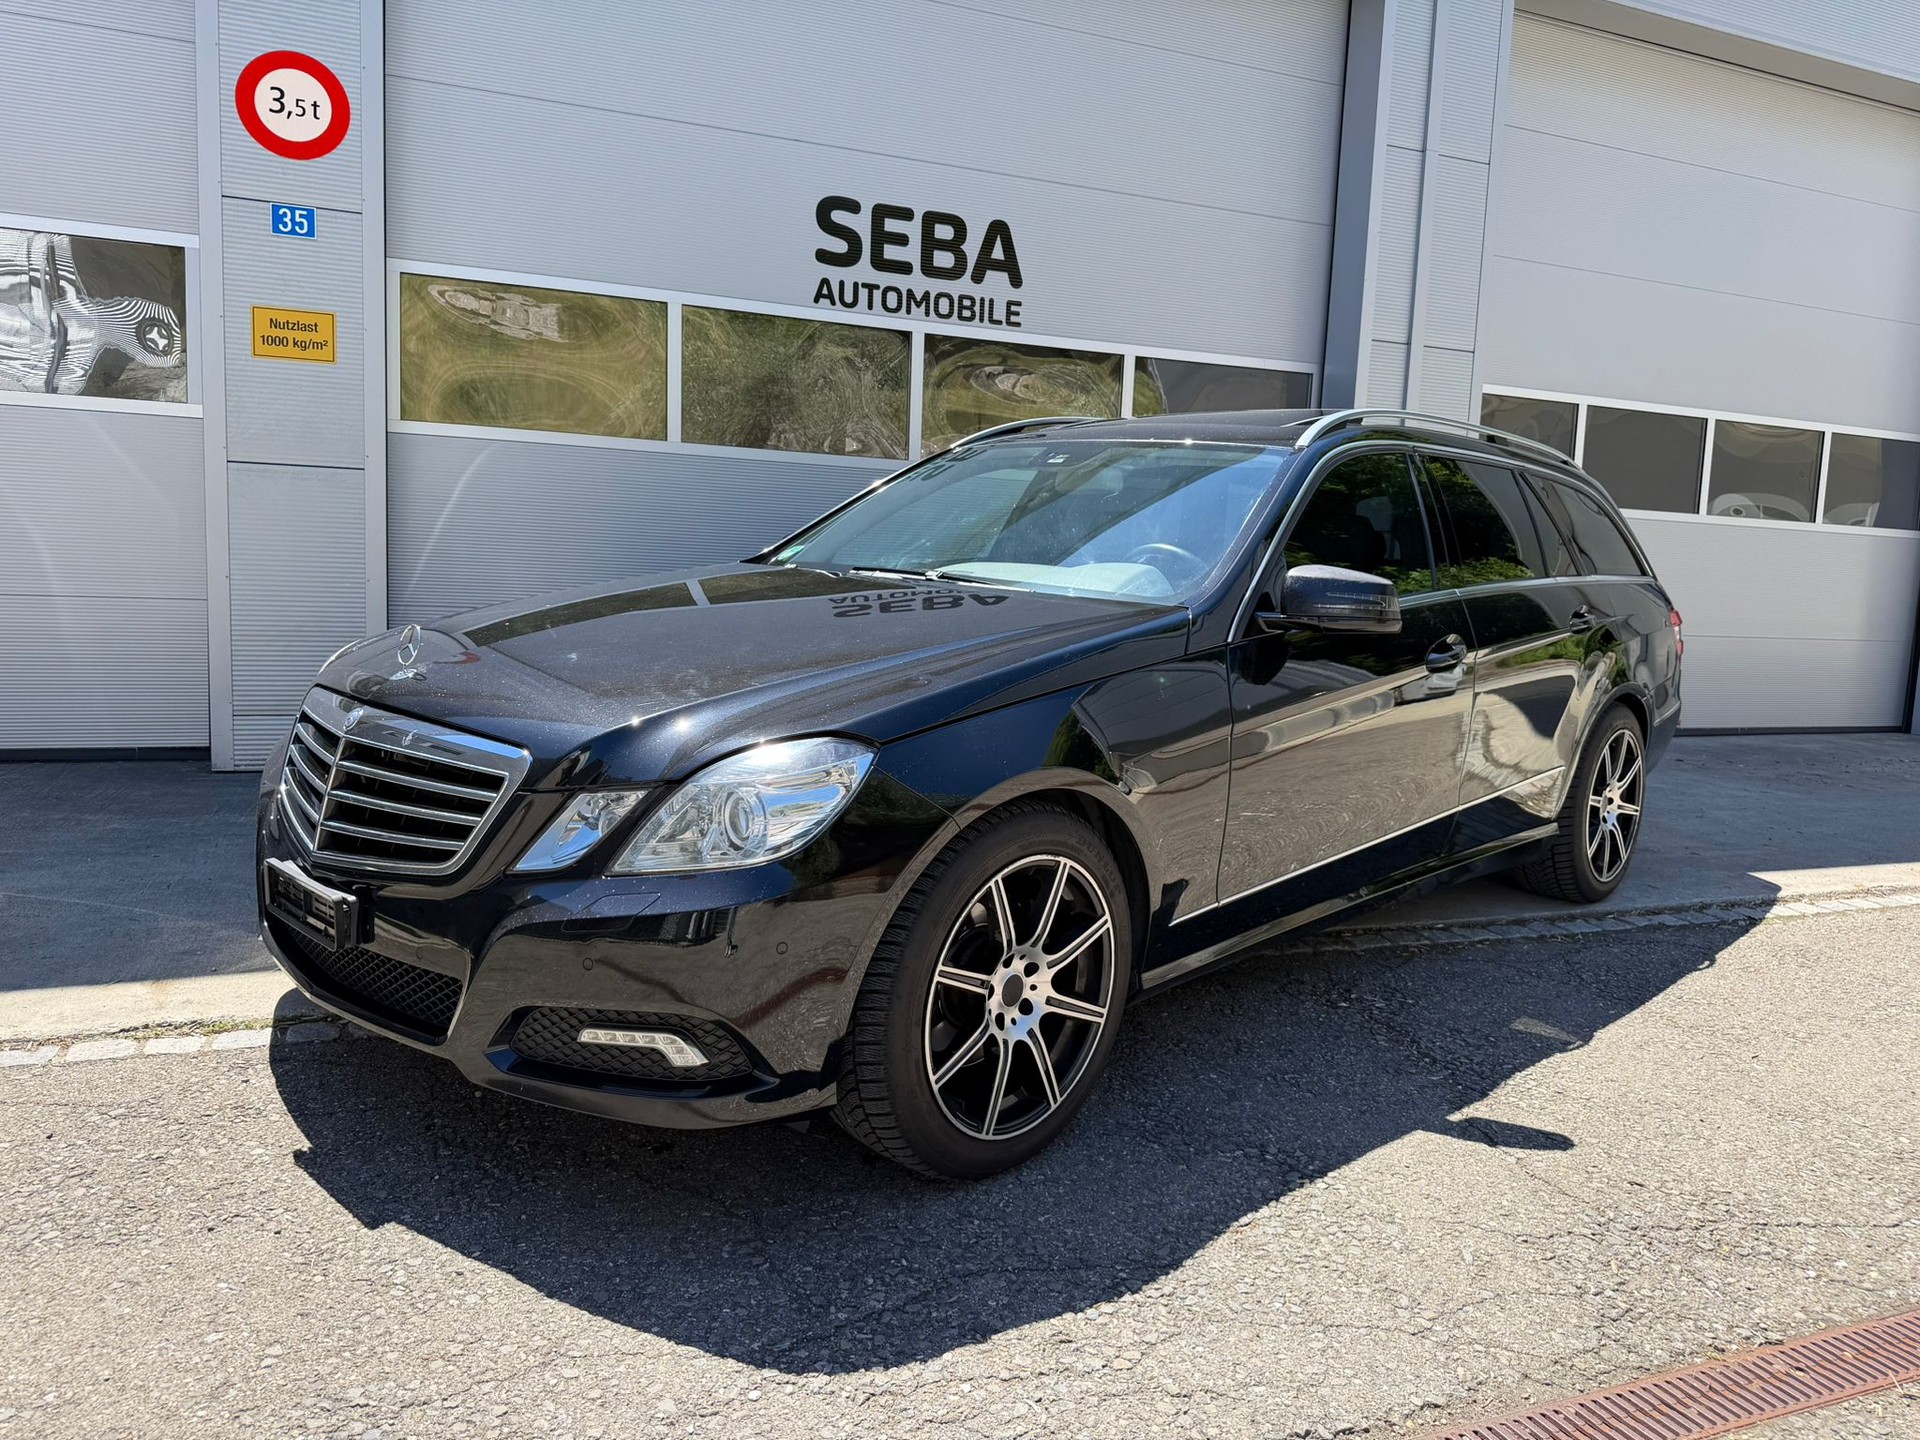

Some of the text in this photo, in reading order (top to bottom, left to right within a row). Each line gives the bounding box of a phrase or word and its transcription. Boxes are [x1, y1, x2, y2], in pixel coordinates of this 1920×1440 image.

[269, 86, 320, 120] 3,5 t
[278, 208, 308, 234] 35
[815, 195, 1023, 289] SEBA
[813, 277, 1022, 327] AUTOMOBILE
[269, 317, 319, 333] Nutzlast
[260, 334, 289, 348] 1000
